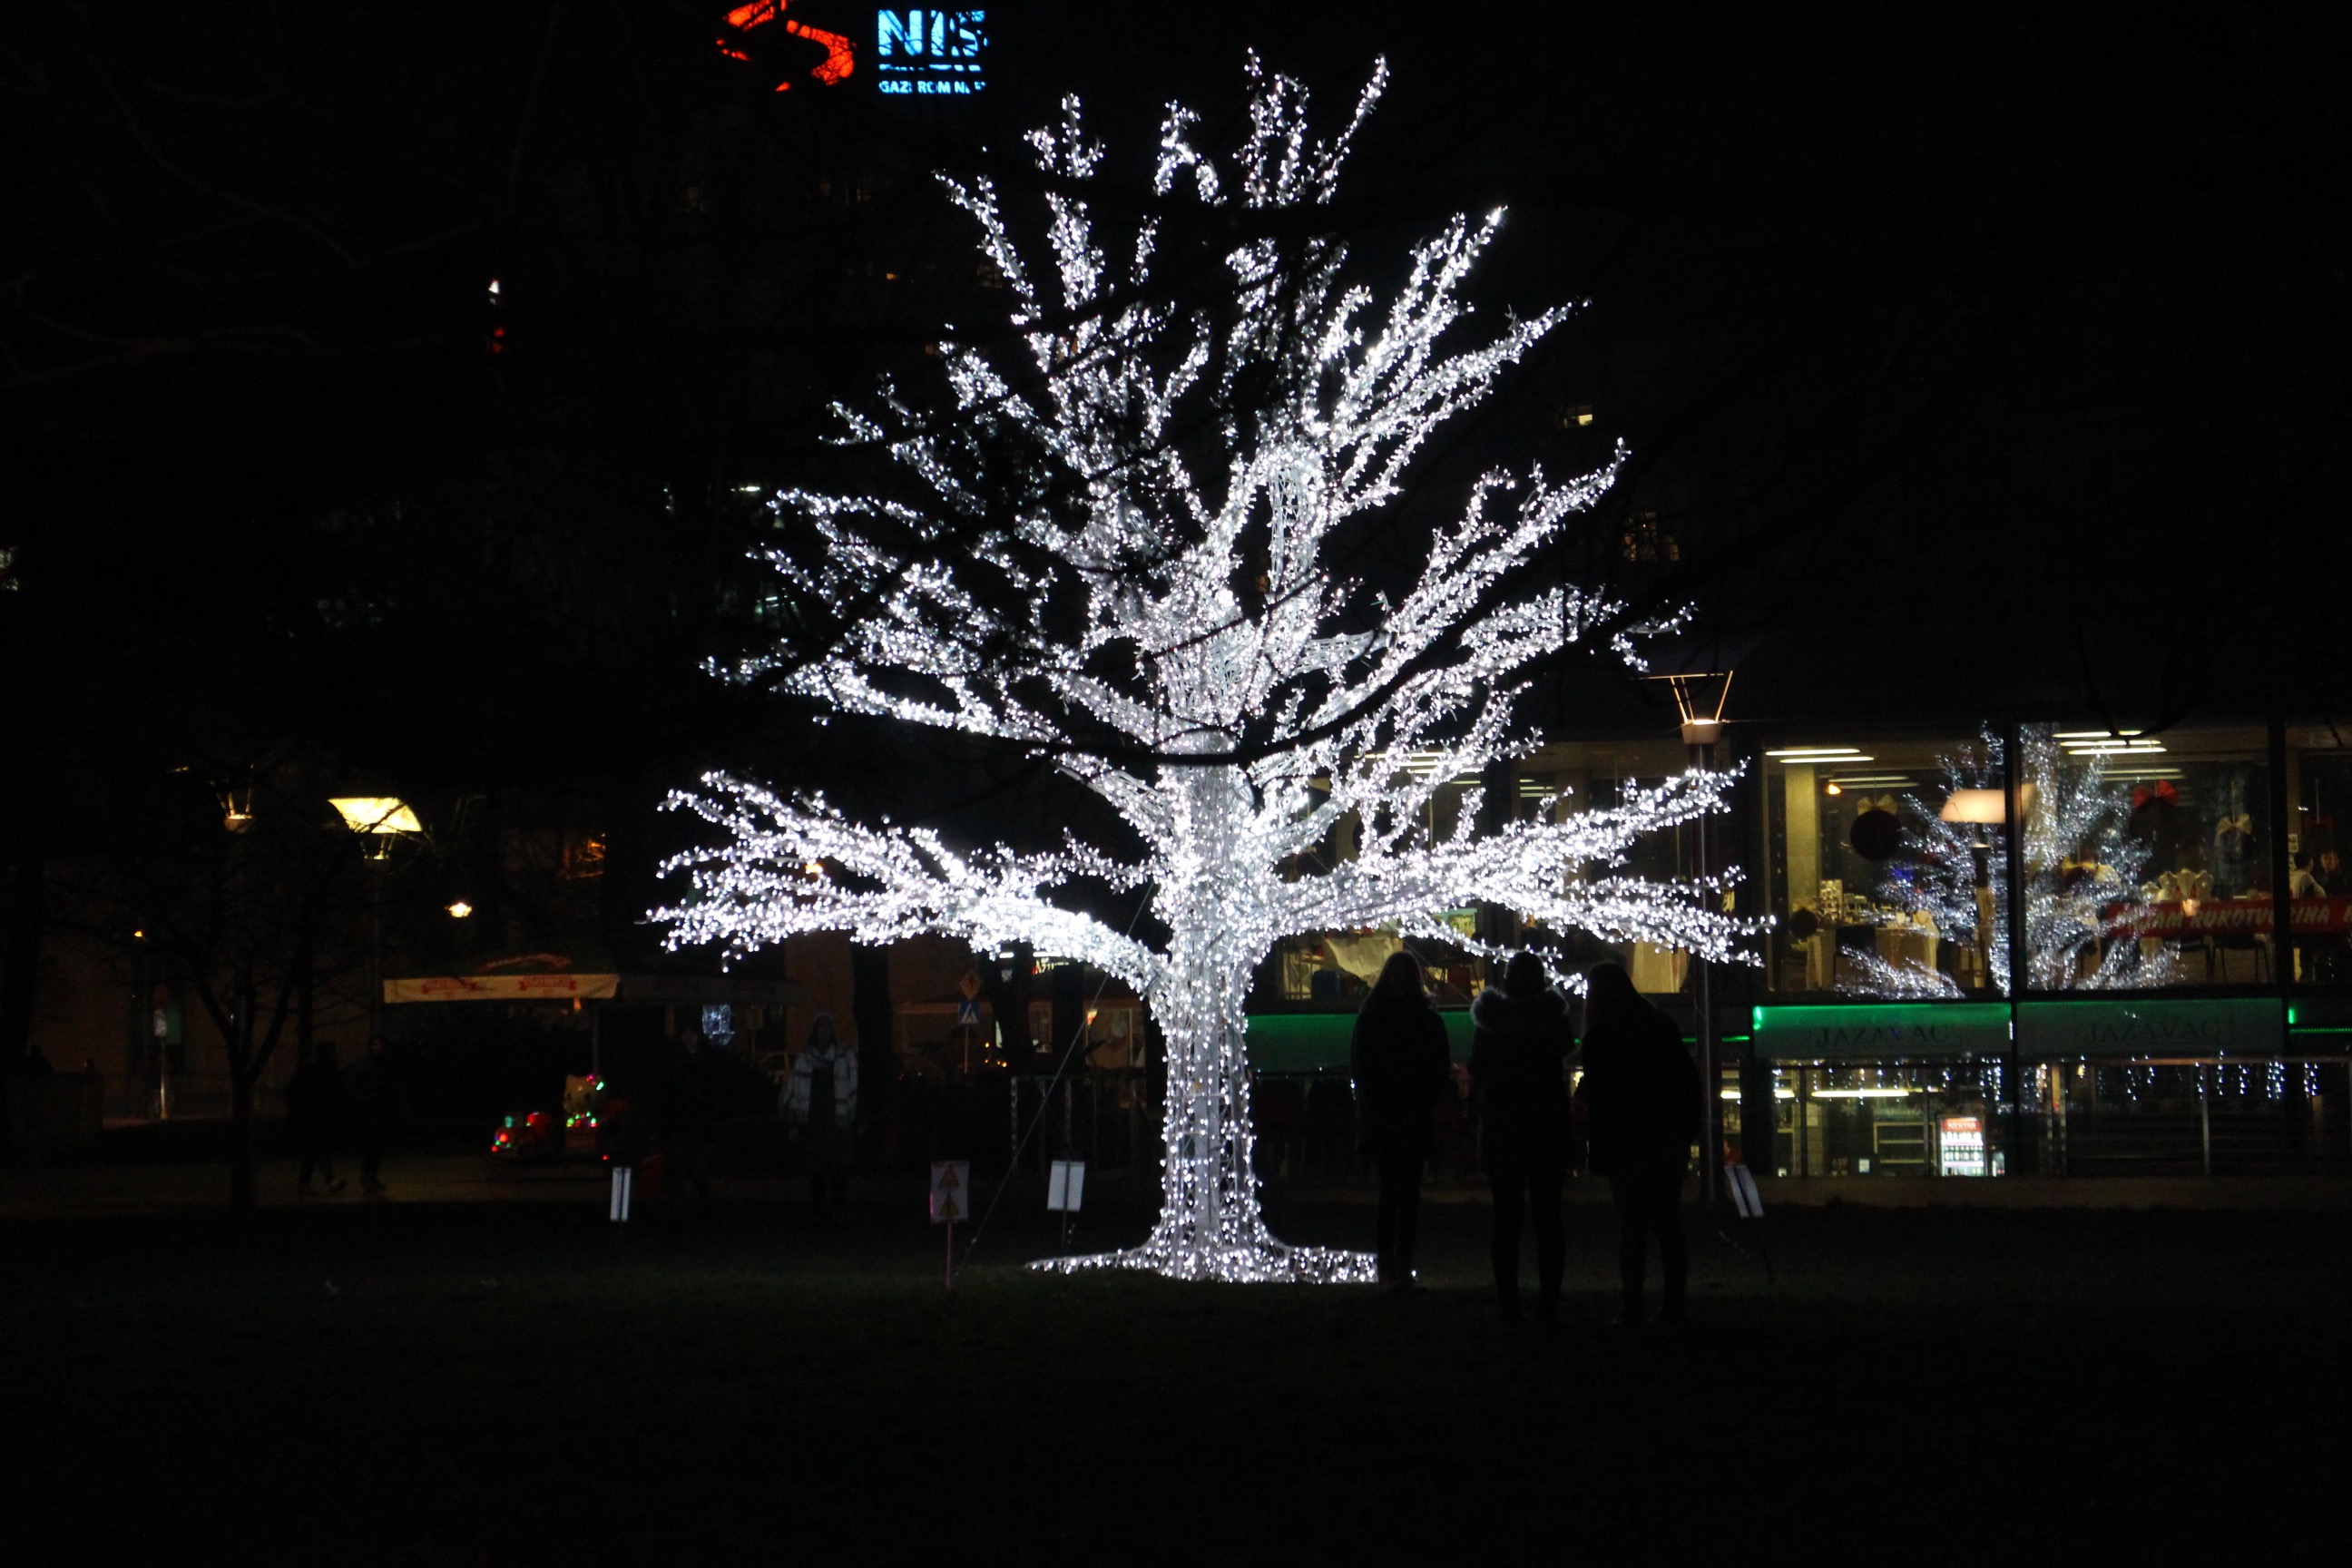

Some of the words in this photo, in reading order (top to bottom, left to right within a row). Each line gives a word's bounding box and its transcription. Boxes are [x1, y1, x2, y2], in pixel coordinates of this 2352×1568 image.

[878, 10, 988, 56] NIS
[878, 81, 951, 94] GAZROM
[1818, 1024, 1949, 1047] JAZAVAC
[2086, 1019, 2222, 1043] JAZAVAC
